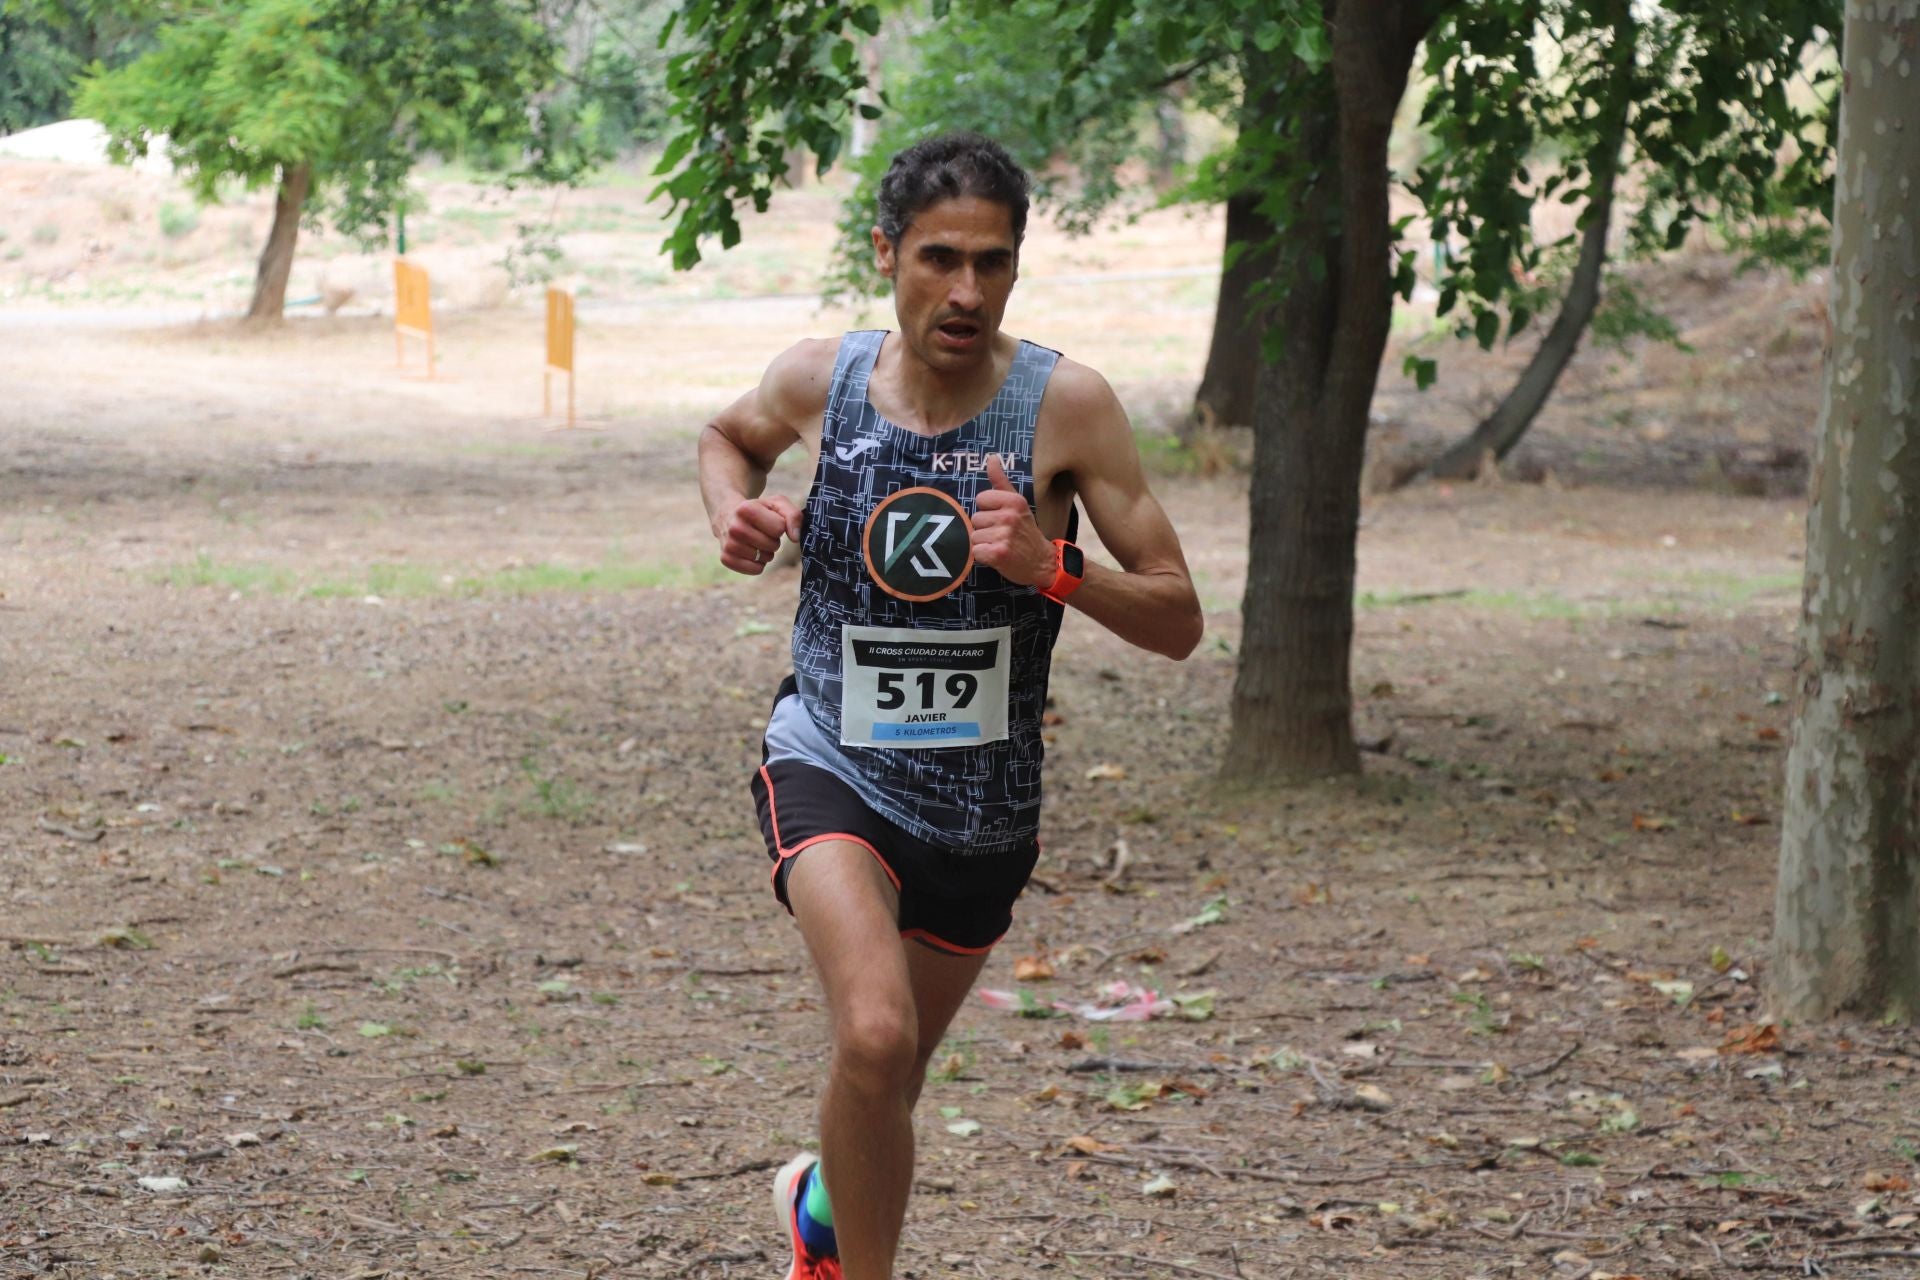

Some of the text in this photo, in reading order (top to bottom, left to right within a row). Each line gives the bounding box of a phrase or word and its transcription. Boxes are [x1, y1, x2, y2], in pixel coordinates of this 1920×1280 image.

[876, 647, 903, 656] CROSS
[905, 648, 937, 656] CIUDAD
[951, 649, 984, 657] ALFARO
[876, 672, 978, 710] 519
[905, 713, 947, 723] JAVIER
